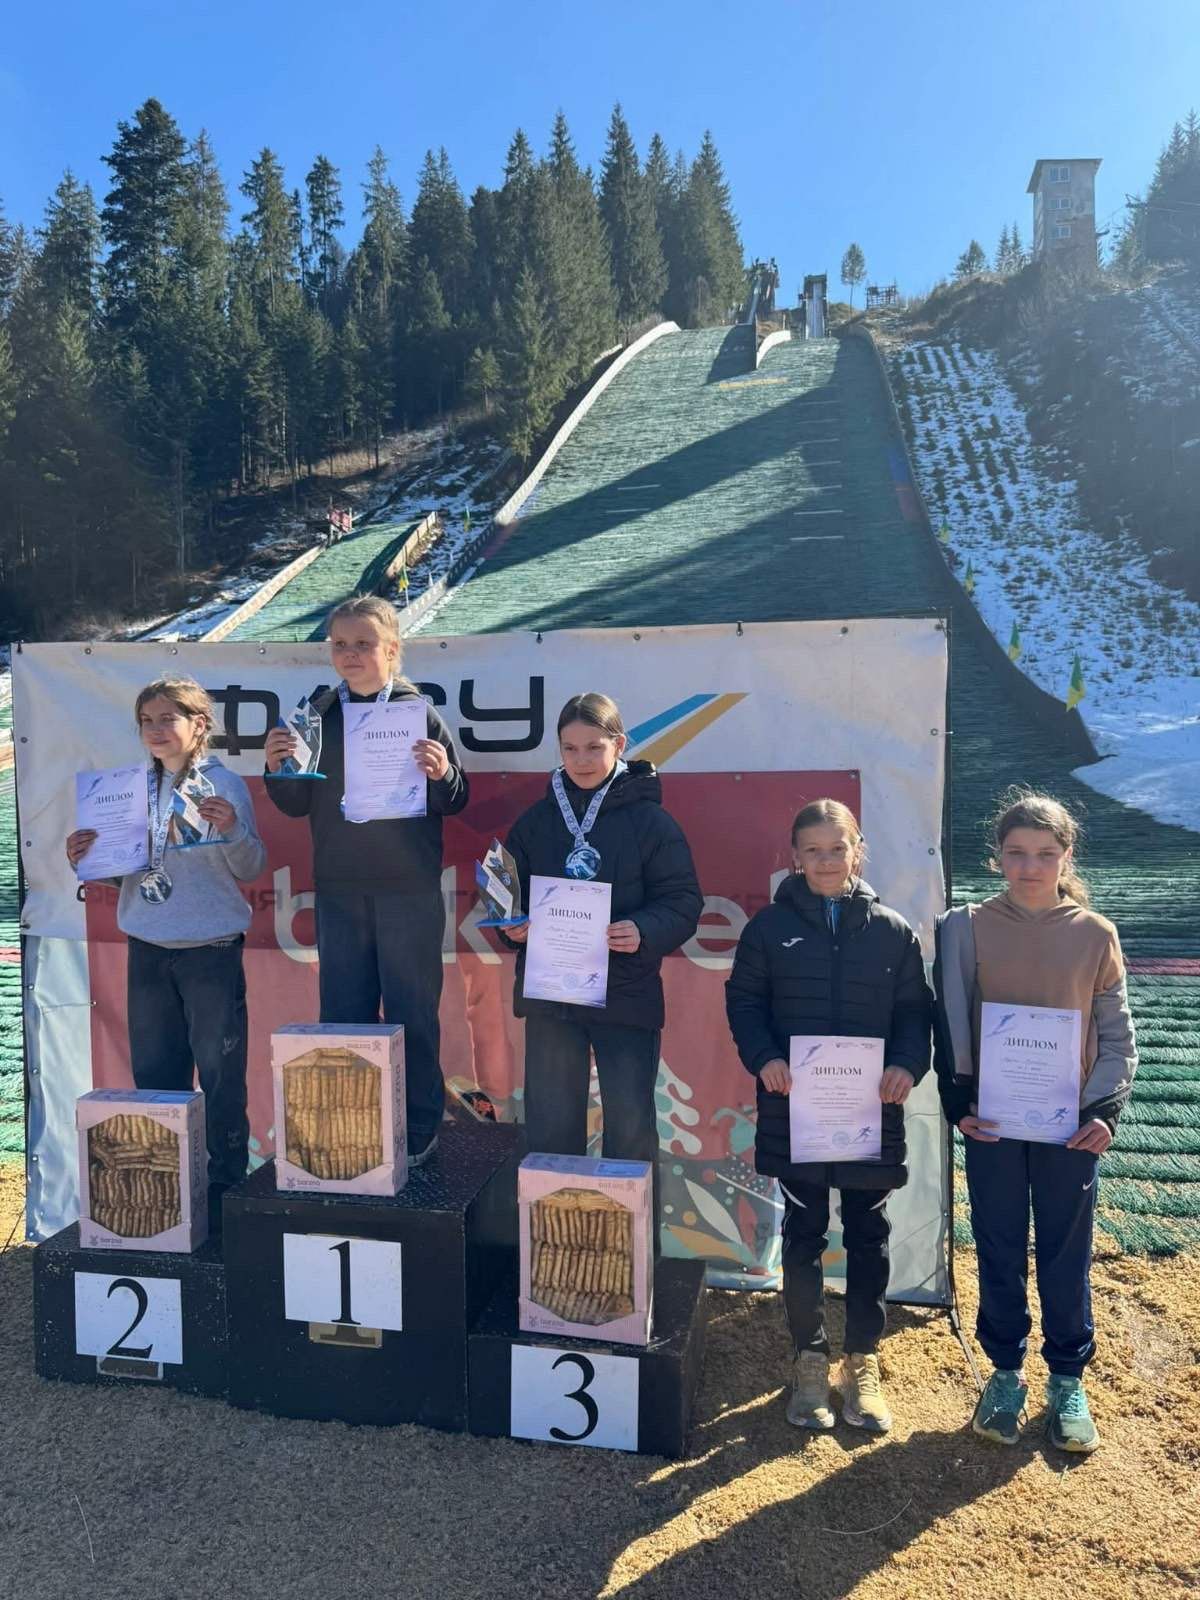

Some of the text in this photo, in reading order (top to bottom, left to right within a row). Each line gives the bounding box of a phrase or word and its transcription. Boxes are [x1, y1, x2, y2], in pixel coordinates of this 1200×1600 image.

[363, 730, 409, 740] ДИПЛОМ
[94, 791, 134, 805] ДИПЛОМ
[547, 907, 592, 921] ДИПЛОМ
[1003, 1036, 1058, 1050] ДИПЛОМ
[811, 1066, 862, 1076] ДИПЛОМ
[329, 1240, 362, 1326] 1
[106, 1277, 154, 1359] 2
[549, 1352, 599, 1441] 3
